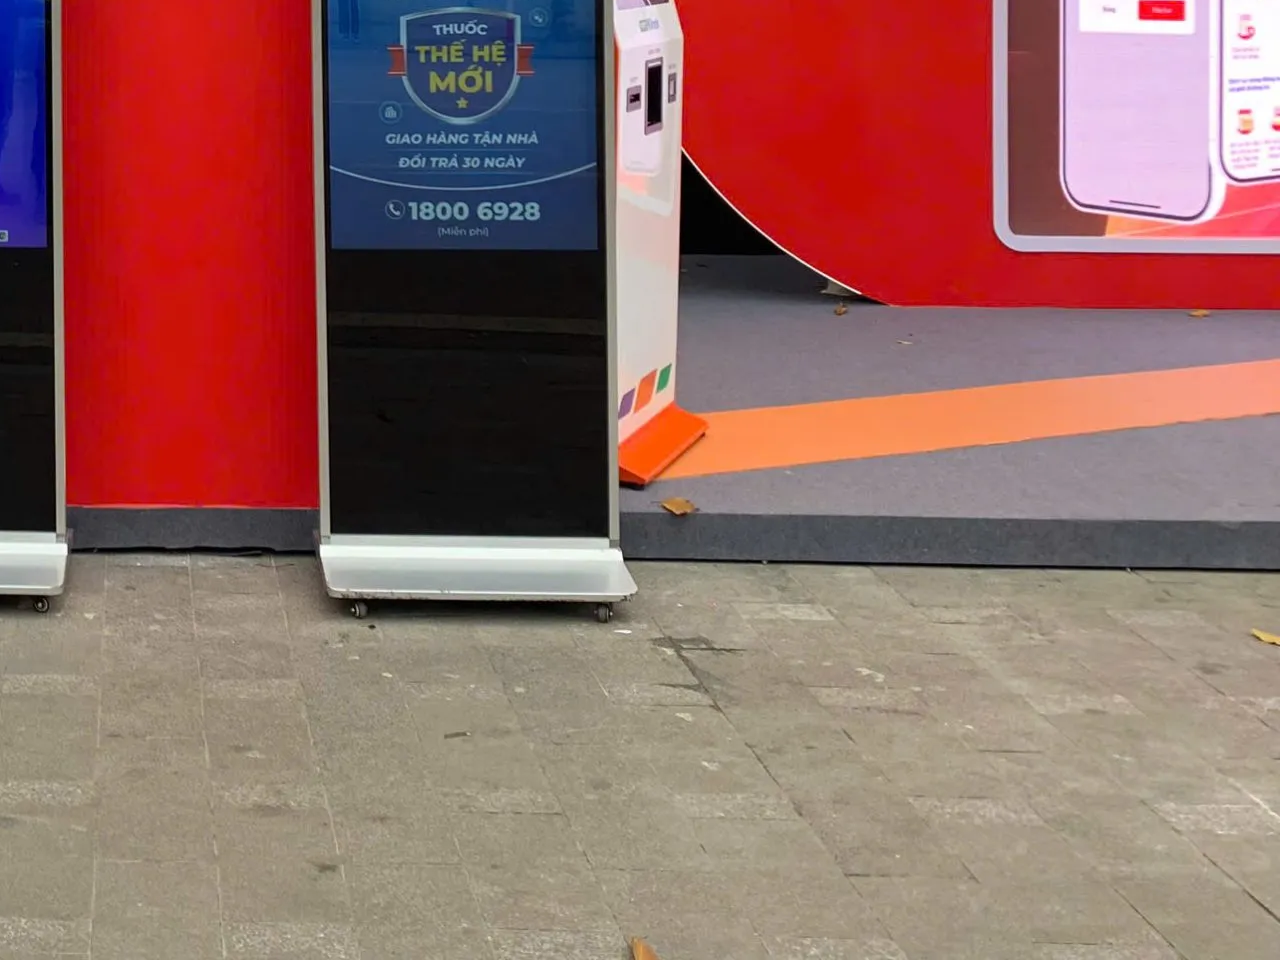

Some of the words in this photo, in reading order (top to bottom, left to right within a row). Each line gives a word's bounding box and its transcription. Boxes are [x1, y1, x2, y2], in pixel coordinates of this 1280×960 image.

[432, 19, 488, 35] THUỐC
[415, 38, 465, 63] THẾ
[473, 40, 507, 66] HỆ
[429, 64, 493, 93] MỚI
[385, 133, 423, 145] GIAO
[426, 131, 470, 145] HÀNG
[473, 131, 502, 147] TẬN
[506, 130, 538, 145] NHÀ
[398, 153, 426, 169] ĐỔI
[430, 153, 460, 168] TRẢ
[462, 157, 480, 168] 30
[483, 155, 526, 168] NGÀY
[408, 201, 469, 221] 1800
[477, 201, 541, 221] 6928
